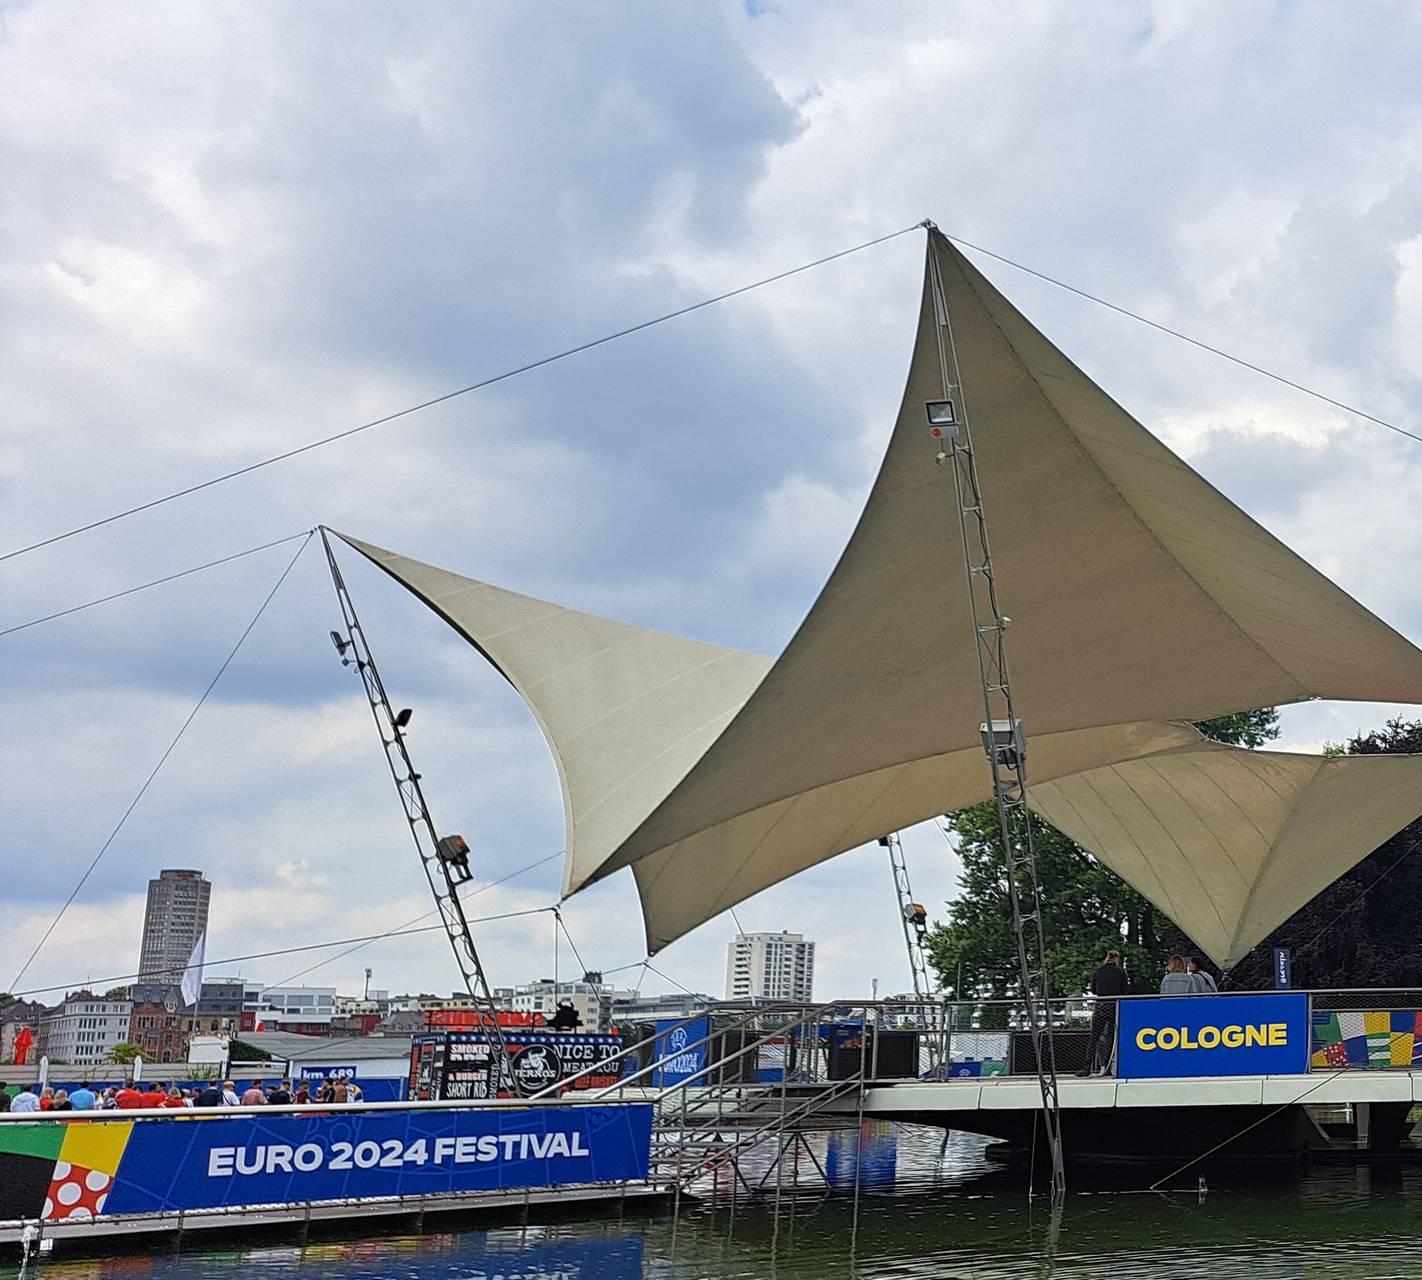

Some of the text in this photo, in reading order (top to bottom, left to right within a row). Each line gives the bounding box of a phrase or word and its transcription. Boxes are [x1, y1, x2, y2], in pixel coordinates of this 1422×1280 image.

[1135, 1023, 1287, 1051] COLOGNE
[552, 1044, 621, 1059] NICE TO
[303, 1070, 324, 1079] km
[446, 1082, 472, 1099] SHORT
[208, 1132, 590, 1177] EURO 2024 FESTIVAL
